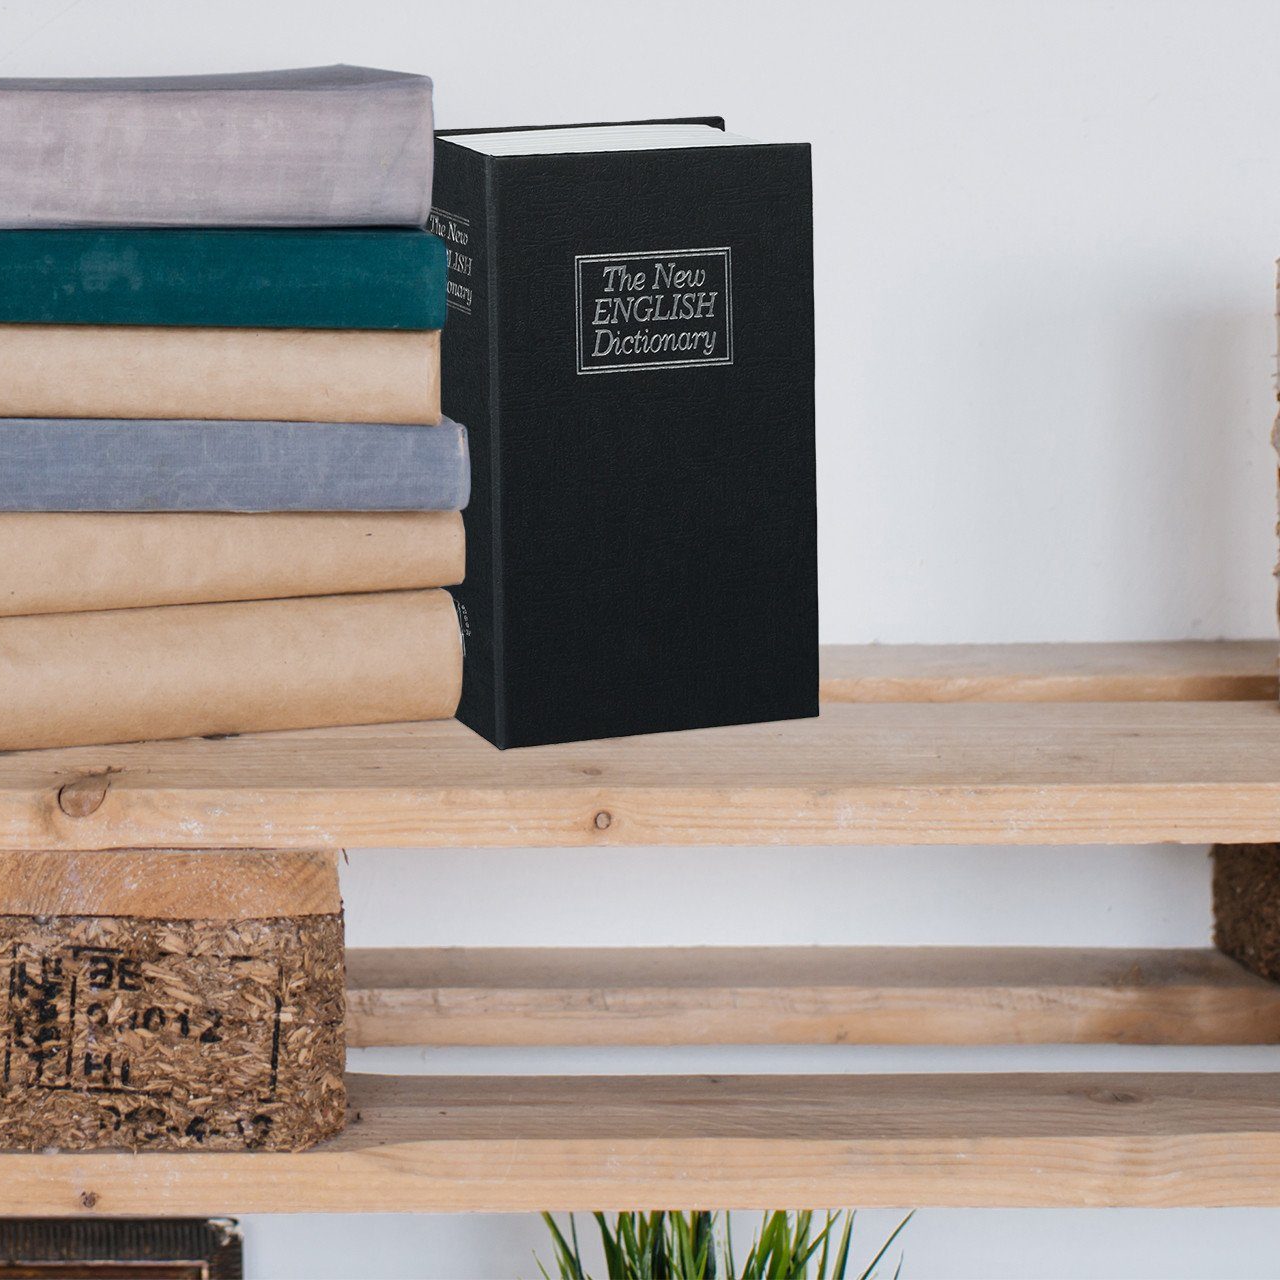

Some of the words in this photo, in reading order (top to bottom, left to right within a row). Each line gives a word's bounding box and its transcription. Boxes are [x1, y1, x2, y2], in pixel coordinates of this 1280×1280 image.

[429, 214, 446, 237] The
[447, 221, 469, 246] New
[446, 249, 473, 276] LISH
[602, 264, 647, 292] The
[651, 262, 706, 290] New
[446, 280, 473, 307] onary
[591, 291, 718, 325] ENGLISH
[591, 328, 717, 357] Dictionary
